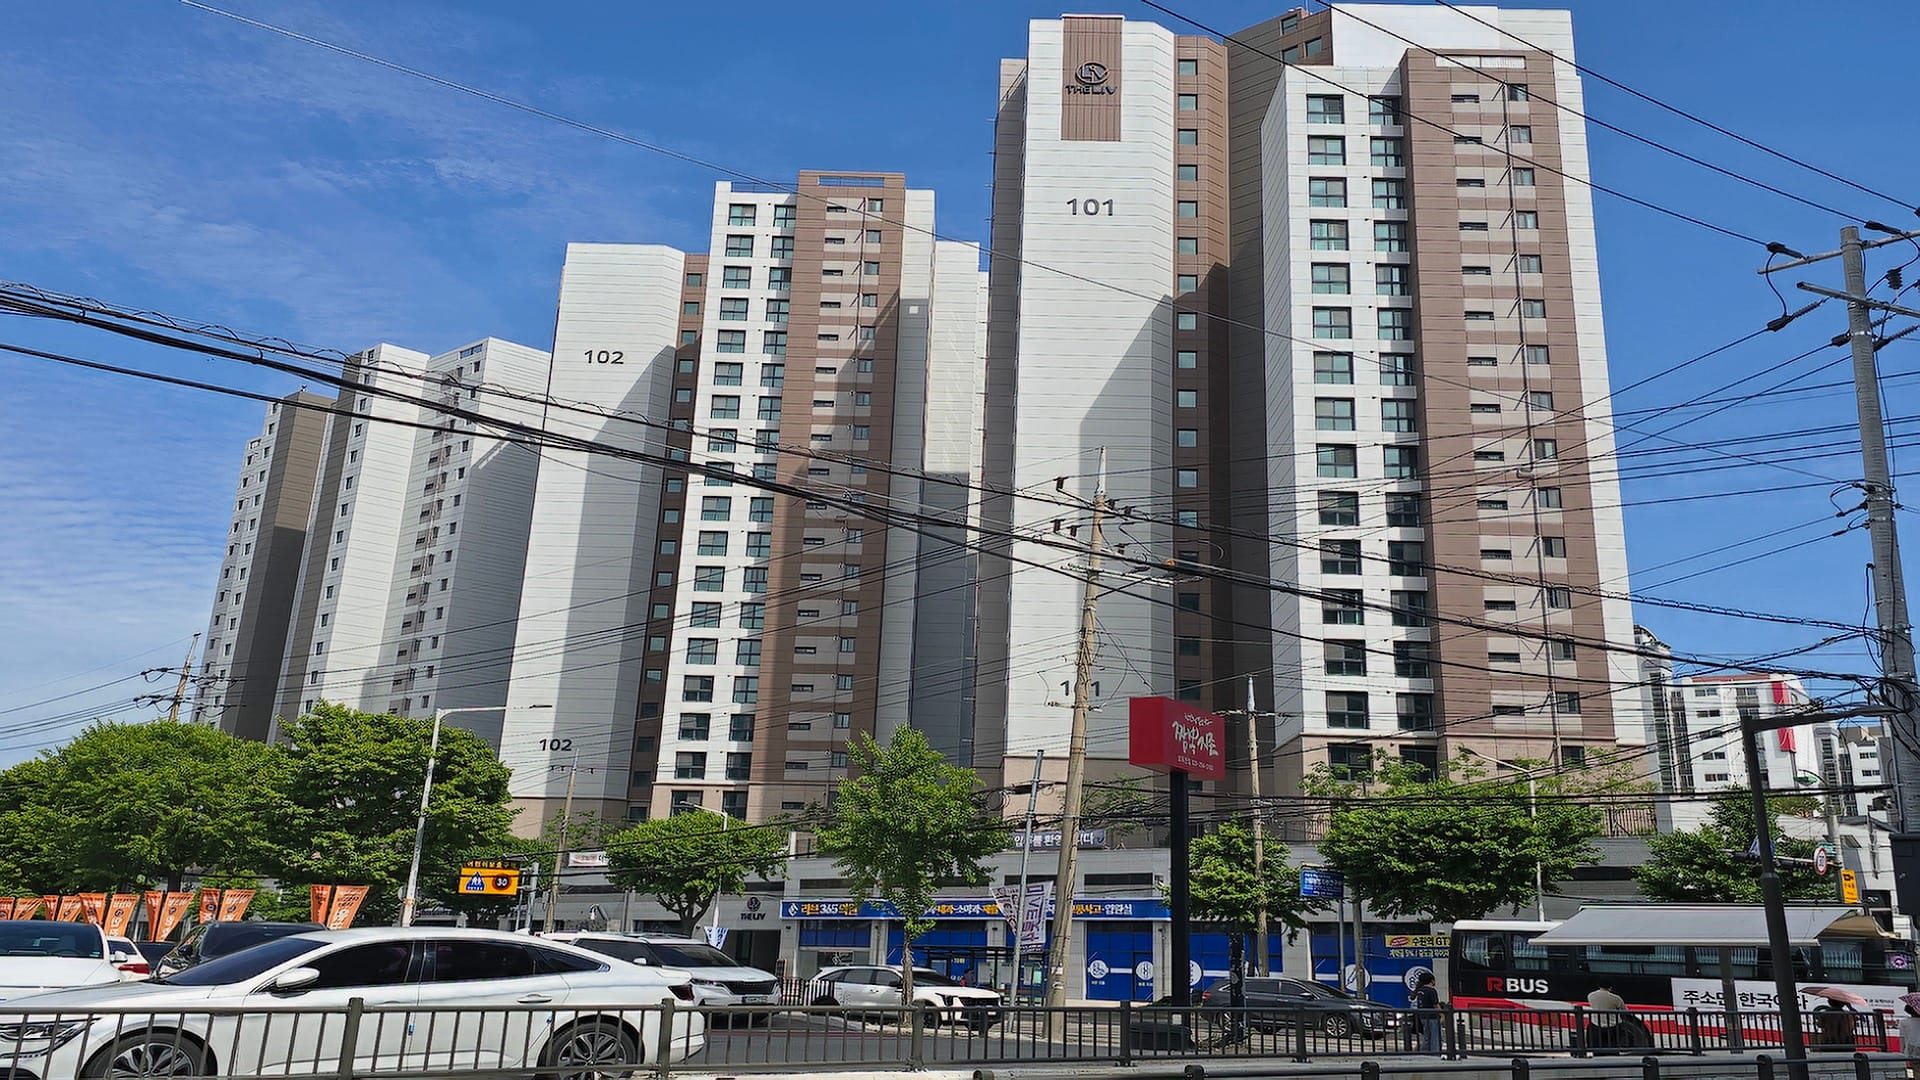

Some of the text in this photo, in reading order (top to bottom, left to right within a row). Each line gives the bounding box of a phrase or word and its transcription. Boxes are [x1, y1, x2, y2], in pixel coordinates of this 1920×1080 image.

[1066, 198, 1114, 217] 101
[584, 350, 624, 365] 102
[1060, 680, 1099, 697] 11
[539, 739, 573, 751] 102
[1014, 834, 1043, 848] 입를
[496, 877, 508, 887] 30
